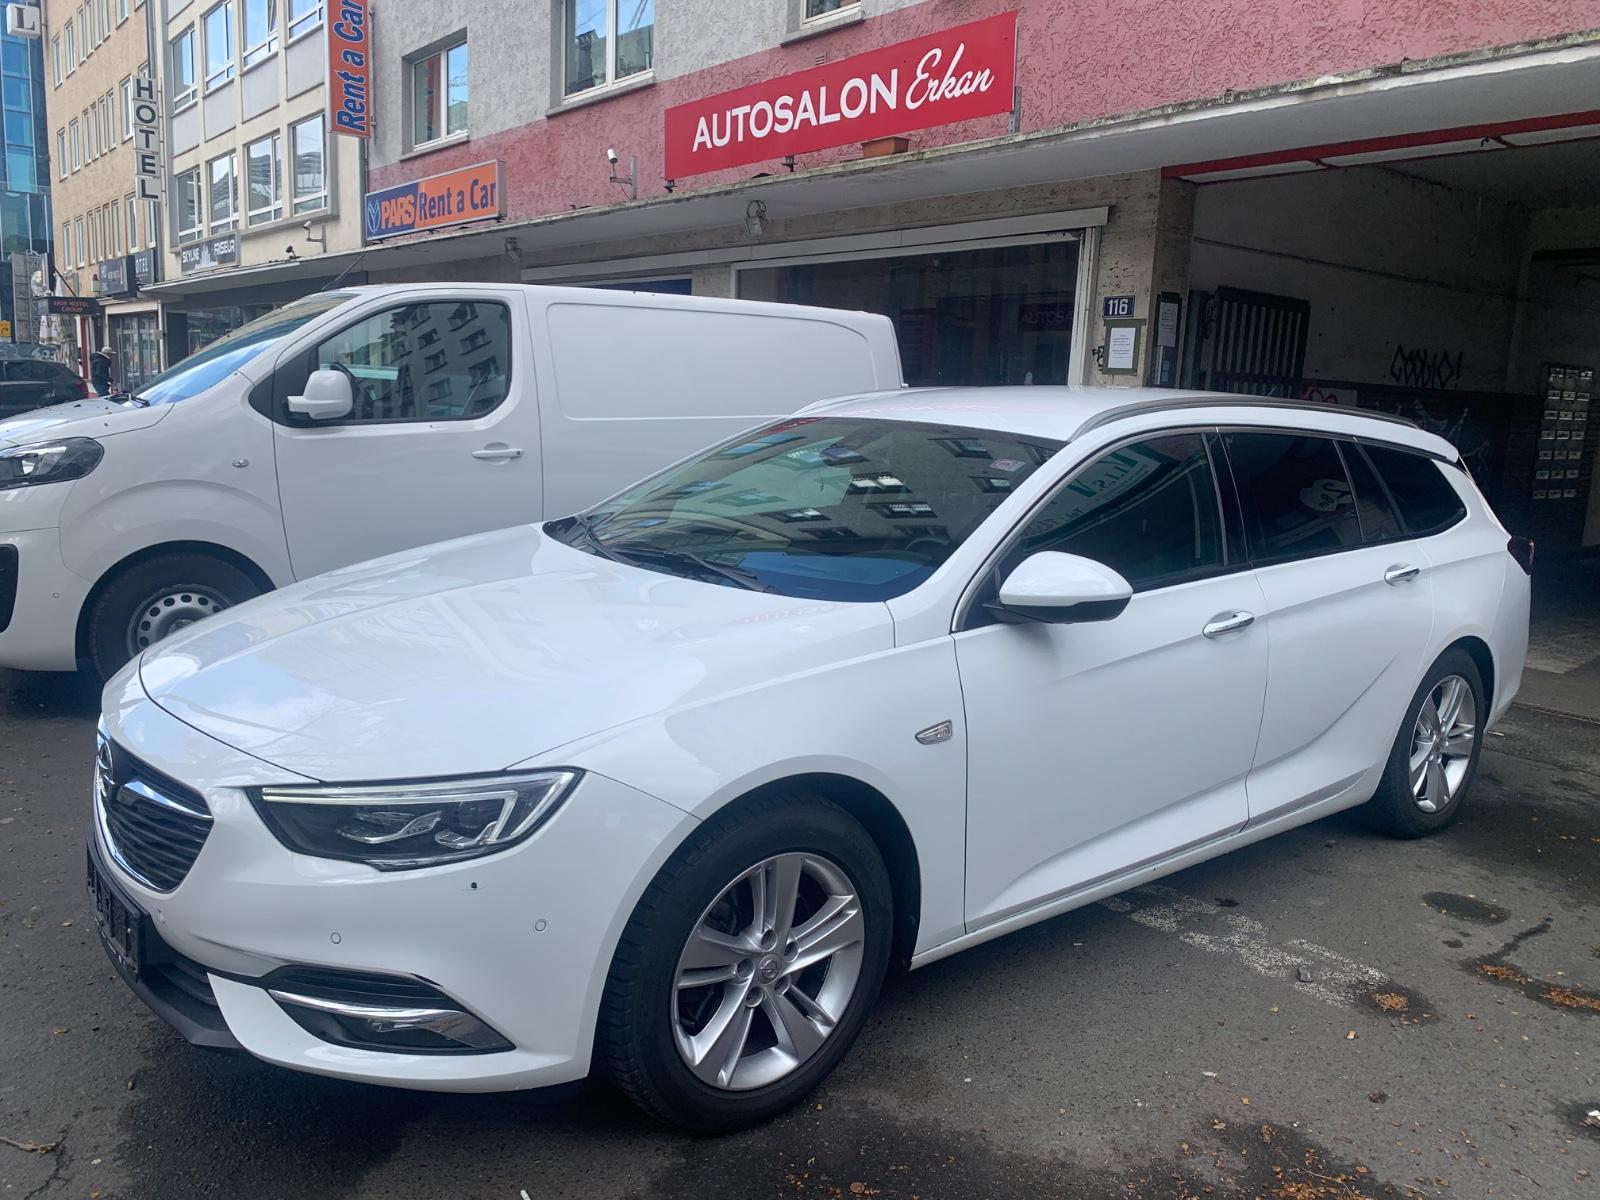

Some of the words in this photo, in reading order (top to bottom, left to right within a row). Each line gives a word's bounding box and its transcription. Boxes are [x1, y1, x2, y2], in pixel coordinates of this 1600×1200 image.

[333, 0, 365, 43] Car
[342, 49, 365, 67] a
[336, 70, 366, 132] Rent
[692, 68, 898, 152] AUTOSALON
[905, 43, 994, 110] Erkan
[136, 78, 158, 199] HOTEL
[381, 194, 415, 229] PARS
[418, 187, 452, 221] Rent
[456, 189, 465, 213] a
[469, 178, 497, 210] Car
[1107, 298, 1129, 316] 116
